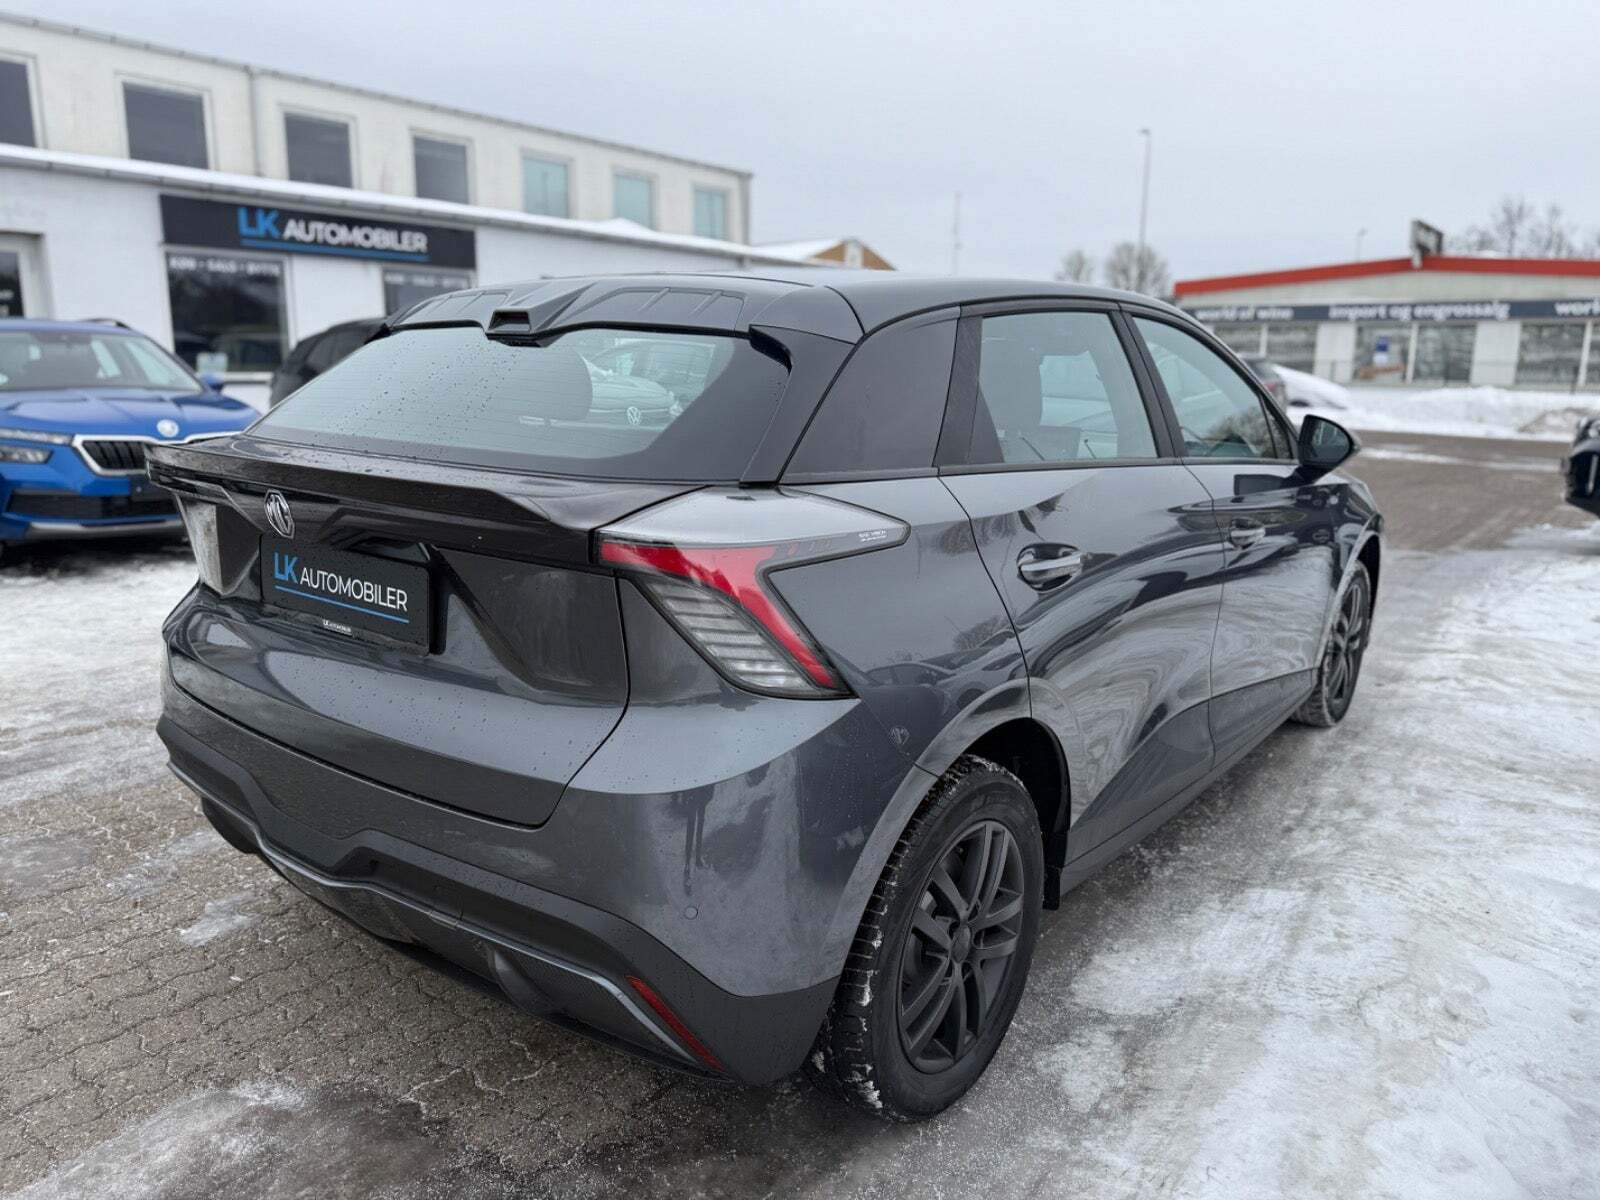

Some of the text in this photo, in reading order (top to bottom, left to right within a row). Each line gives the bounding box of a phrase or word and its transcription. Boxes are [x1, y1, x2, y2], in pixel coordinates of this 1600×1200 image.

[236, 206, 428, 253] LK AUTOMOBILER
[274, 552, 408, 612] LK AUTOMOBILER
